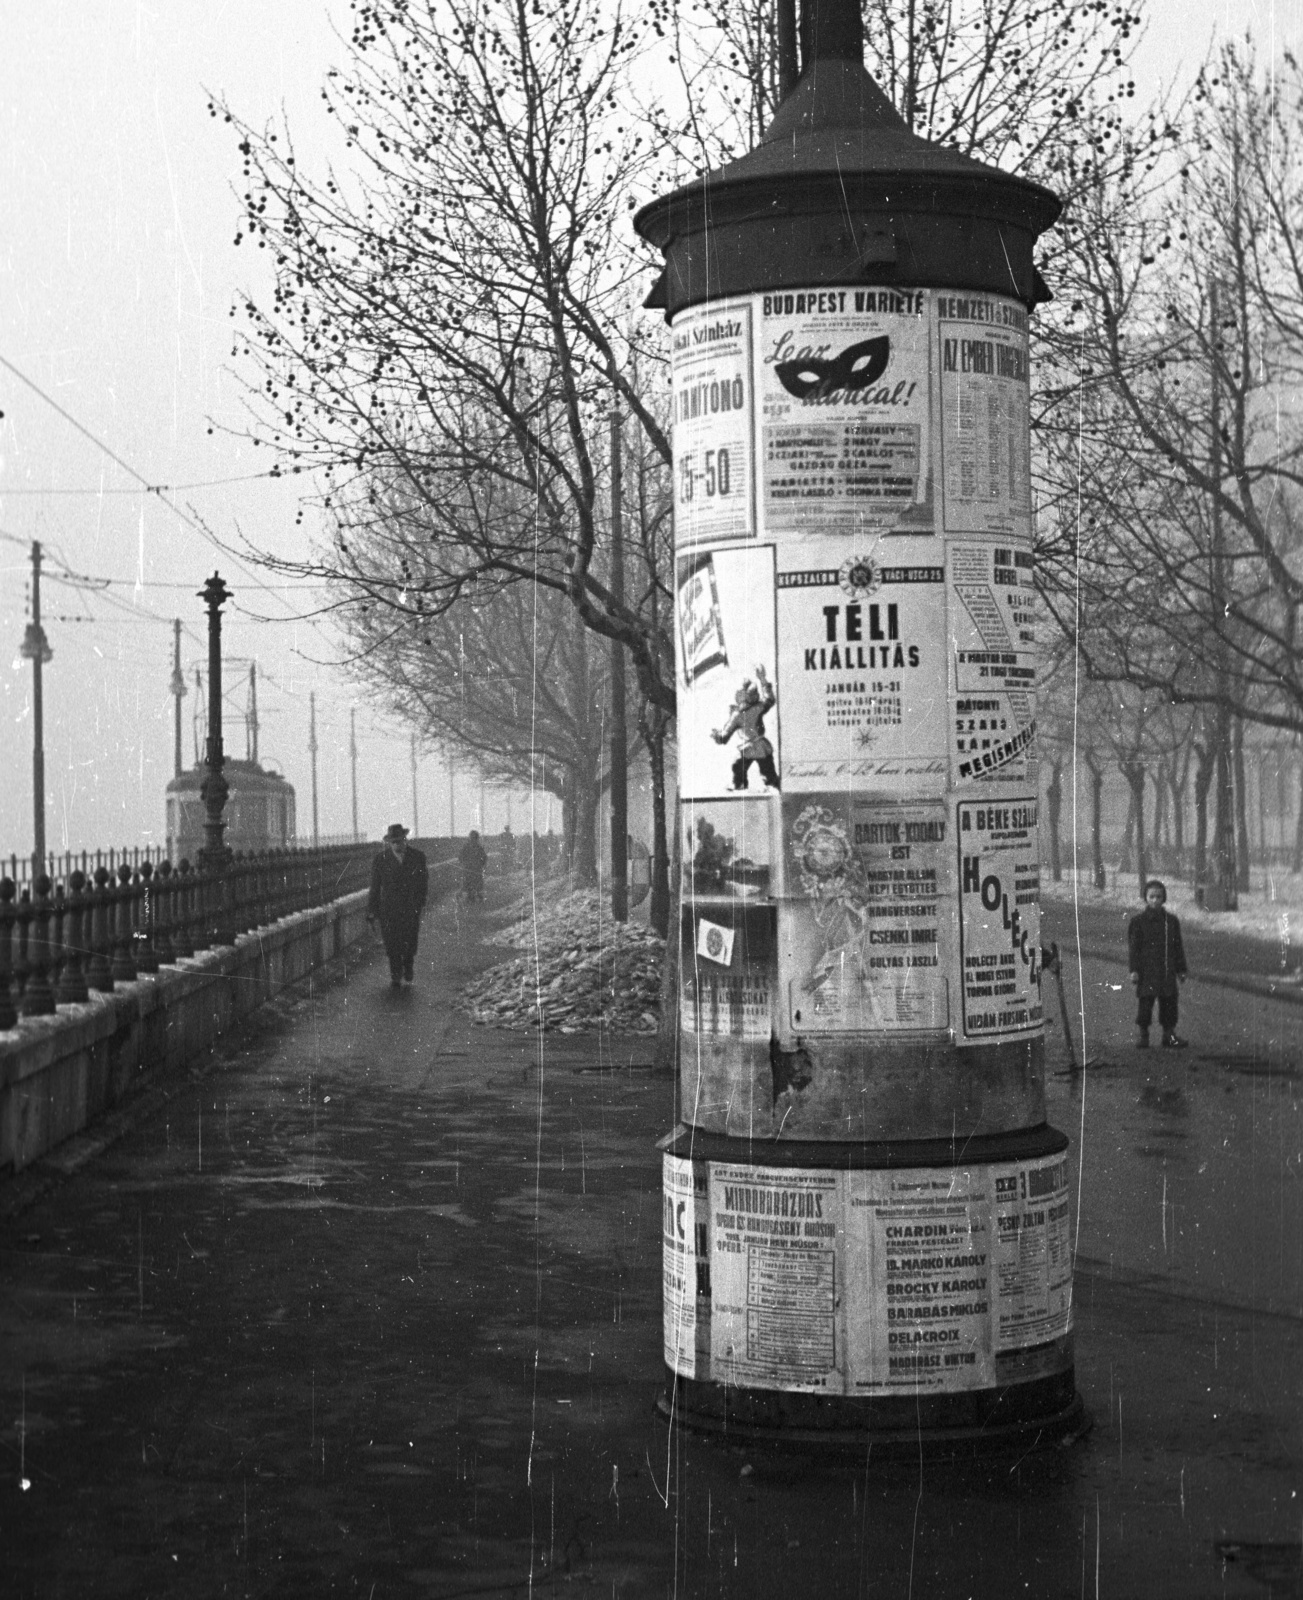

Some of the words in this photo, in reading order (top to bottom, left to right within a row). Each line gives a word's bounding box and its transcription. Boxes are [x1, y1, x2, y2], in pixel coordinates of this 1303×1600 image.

[763, 292, 846, 316] BUDAPEST
[855, 290, 924, 315] VARIETÉ
[938, 298, 994, 322] NEMZETI
[944, 338, 958, 373] AZ
[823, 600, 899, 643] TÉLI
[826, 680, 866, 694] JANUÁR
[962, 810, 971, 831] A
[977, 807, 1009, 831] BÉKE
[891, 845, 910, 860] EST
[886, 1225, 948, 1238] CHARDIN
[887, 1282, 939, 1296] BROCKY
[888, 1329, 960, 1344] DELACROIX
